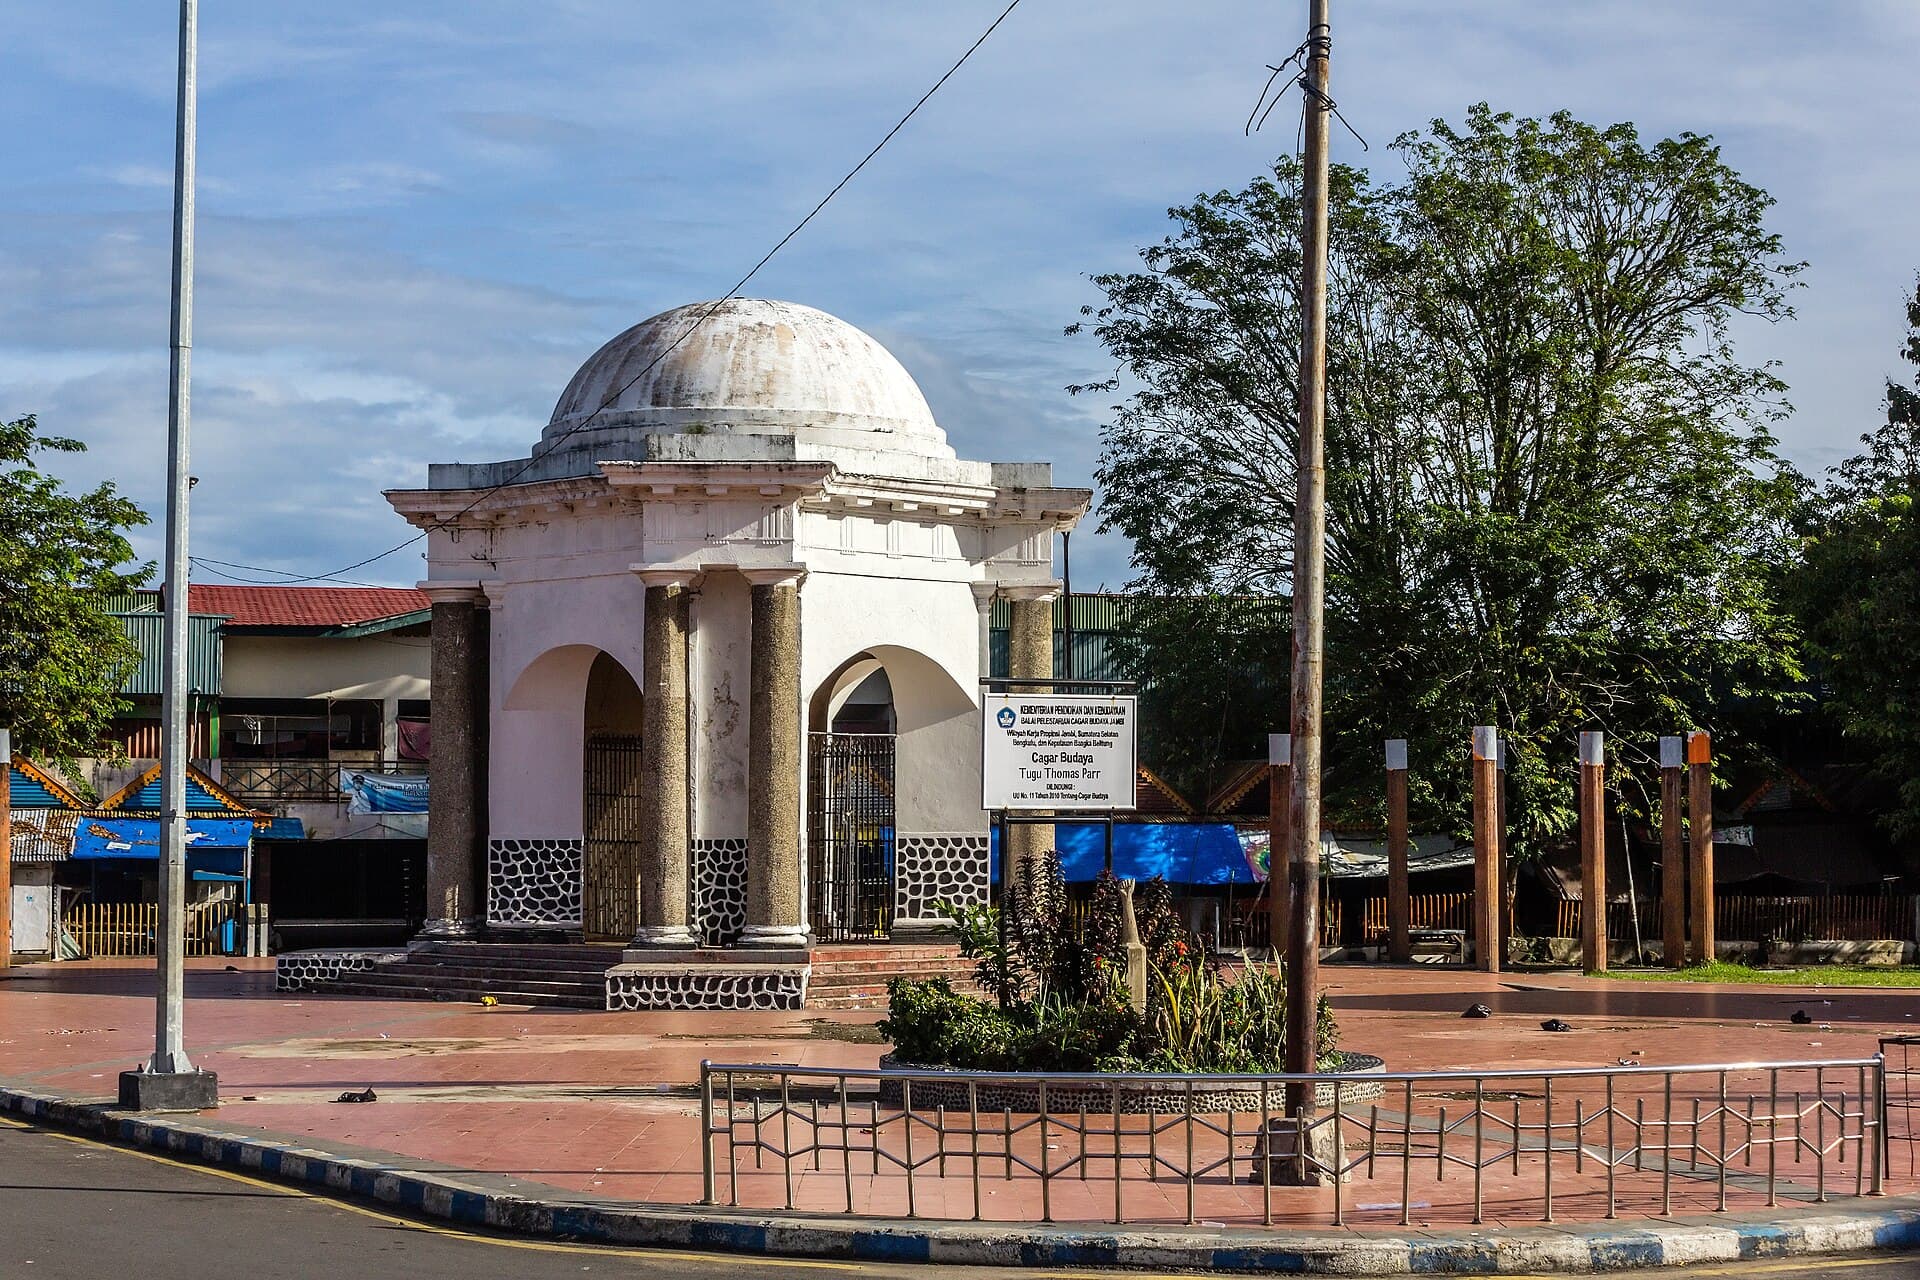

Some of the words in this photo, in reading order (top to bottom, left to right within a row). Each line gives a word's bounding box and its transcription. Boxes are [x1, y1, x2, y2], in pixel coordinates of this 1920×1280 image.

[1020, 705, 1054, 714] KEMENTERIAN
[1055, 705, 1082, 714] PENDIDIKAN
[1084, 706, 1094, 715] DAN
[1095, 706, 1126, 716] KEBUDAYAAN
[1007, 730, 1026, 738] Wilayah
[1027, 730, 1039, 738] Kerja
[1048, 739, 1073, 748] Kepulauan
[1074, 740, 1091, 748] Bangka
[1032, 752, 1058, 765] Cagar
[1060, 752, 1094, 766] Budaya
[1018, 768, 1042, 781] Tugu
[1044, 768, 1080, 779] Thomas
[1082, 768, 1101, 779] Parr
